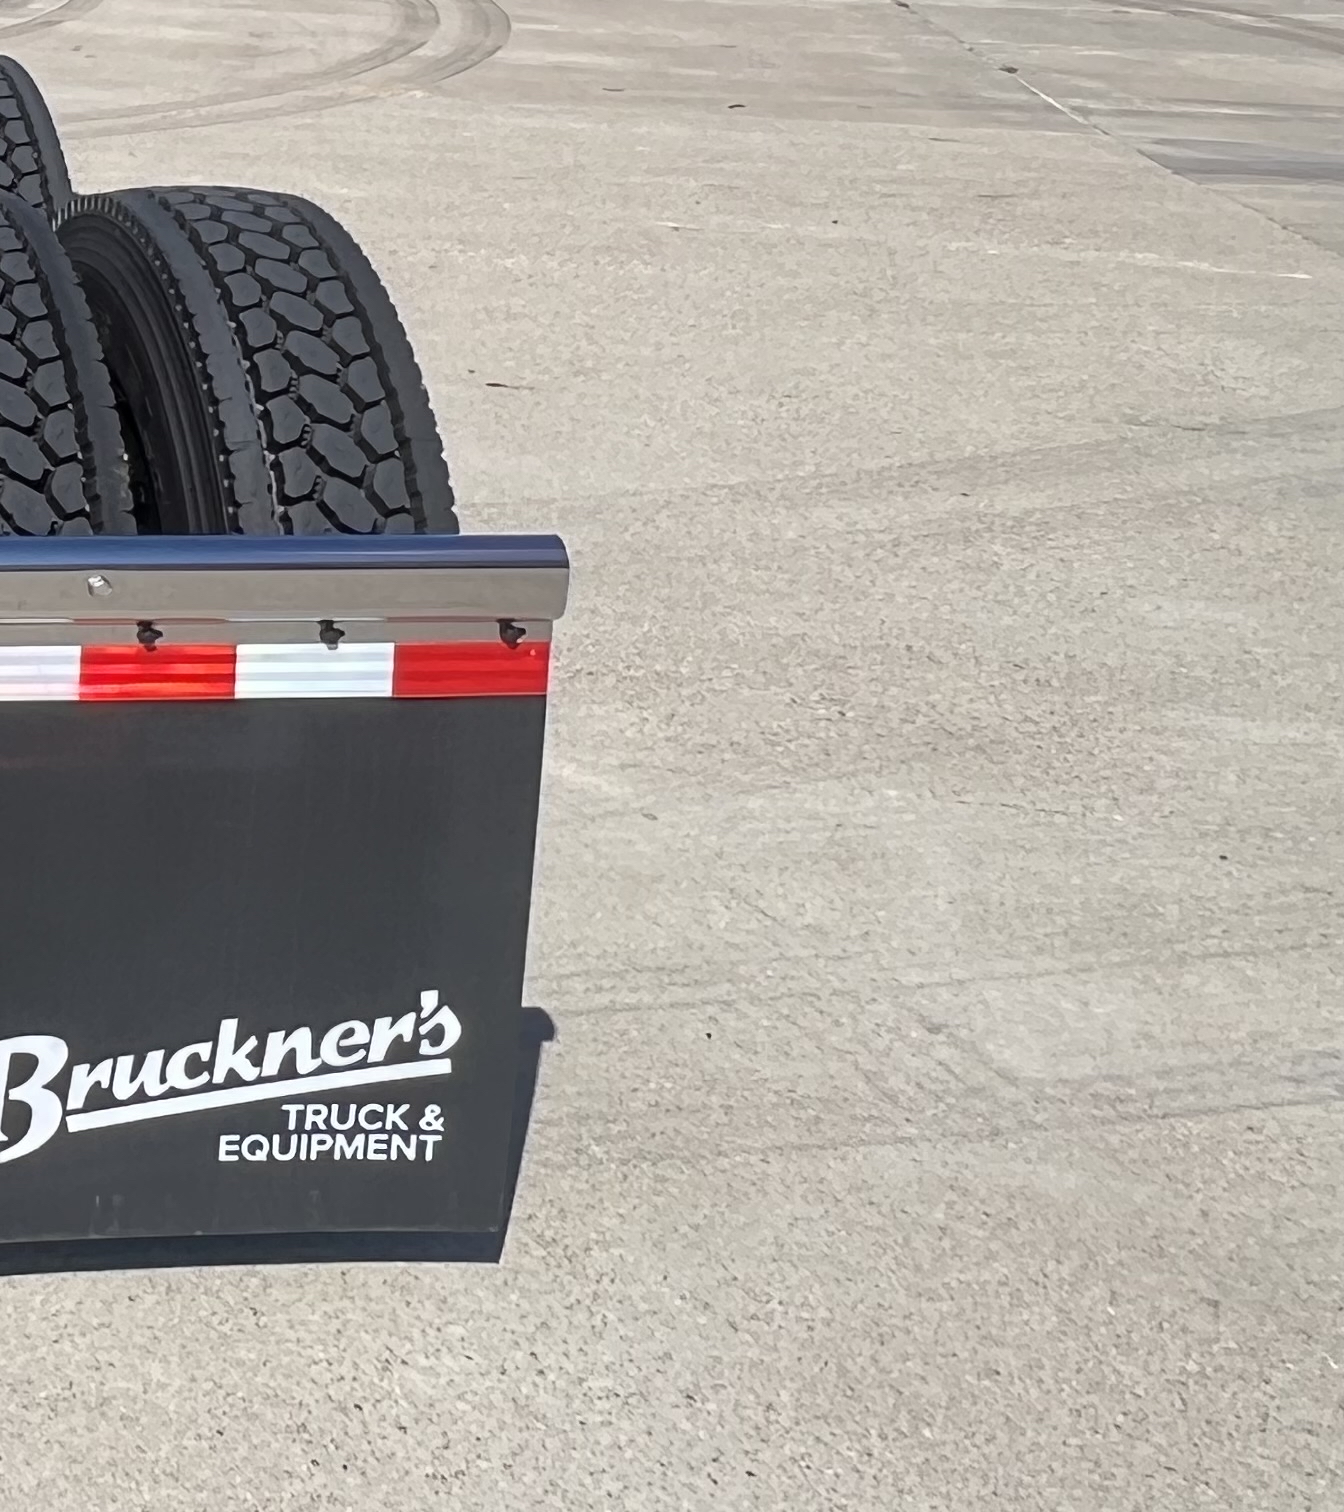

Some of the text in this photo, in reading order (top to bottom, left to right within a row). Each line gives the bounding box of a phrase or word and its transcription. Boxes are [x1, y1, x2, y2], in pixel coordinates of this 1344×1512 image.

[280, 1103, 445, 1132] TRUCK &
[218, 1133, 443, 1162] EQUIPMENT
